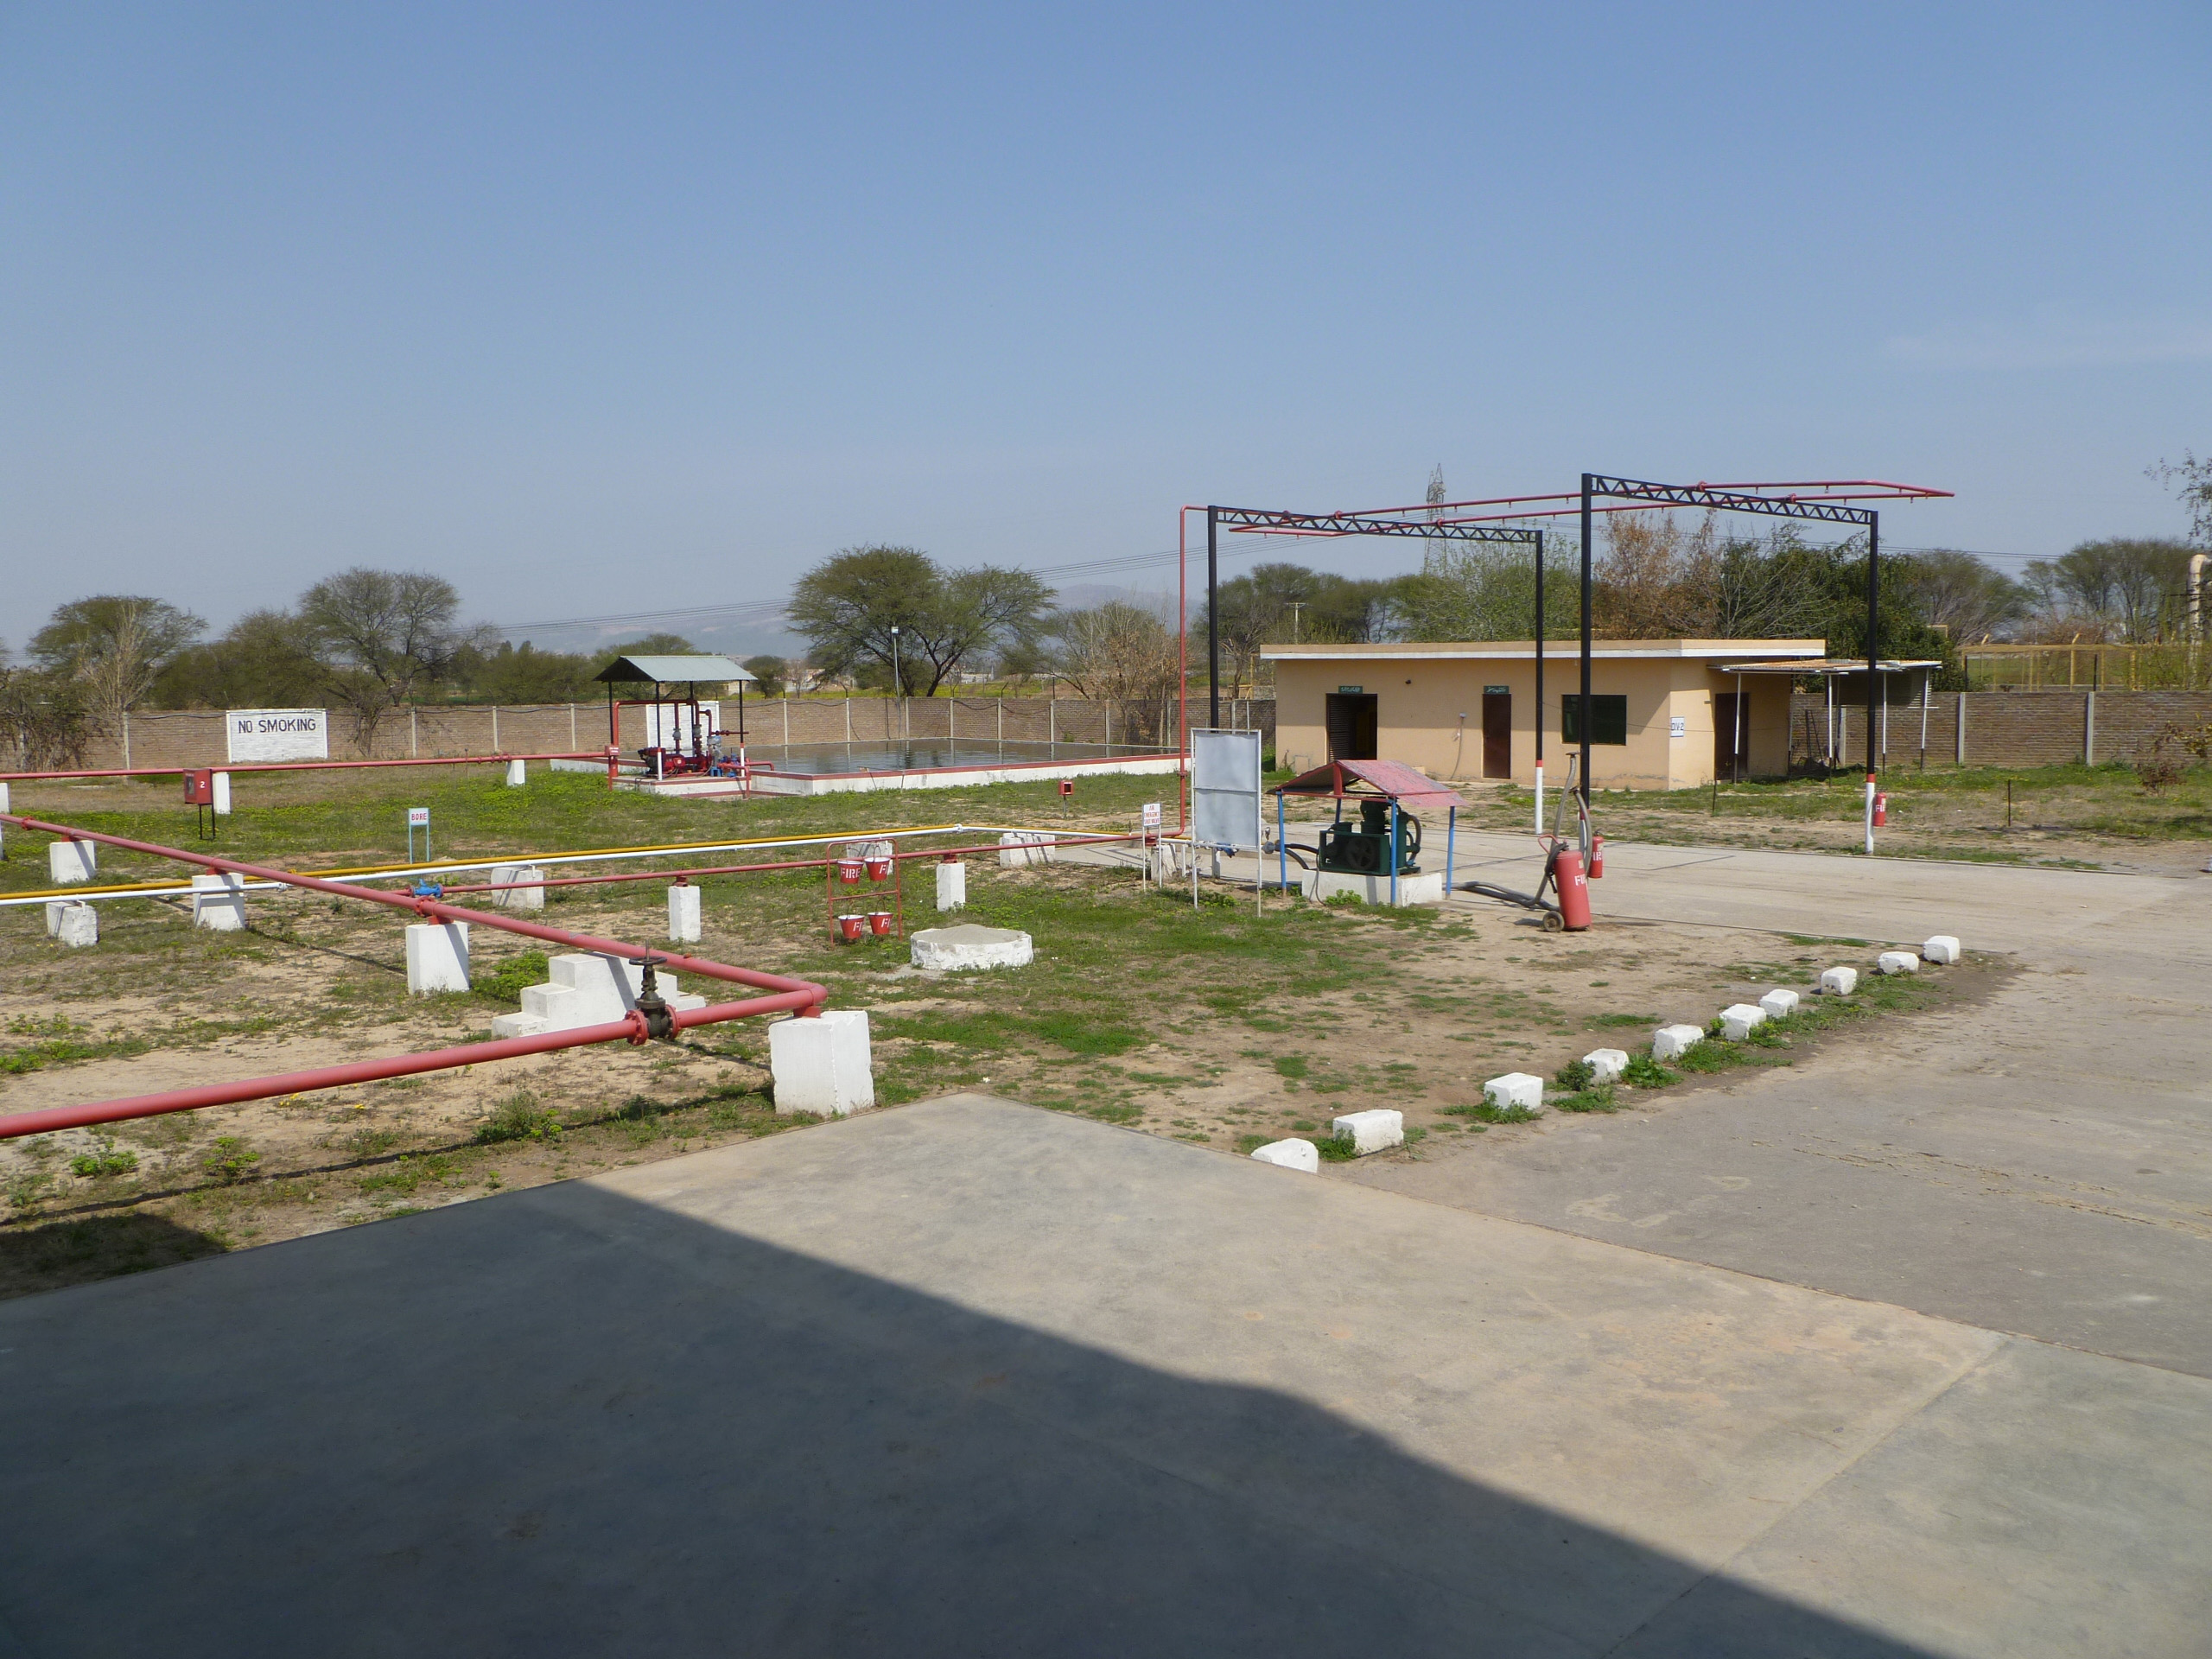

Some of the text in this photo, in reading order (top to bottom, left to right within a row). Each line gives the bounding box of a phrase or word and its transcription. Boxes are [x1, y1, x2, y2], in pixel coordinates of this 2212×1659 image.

[238, 718, 316, 734] NO SMOKING
[841, 868, 861, 879] FIRE
